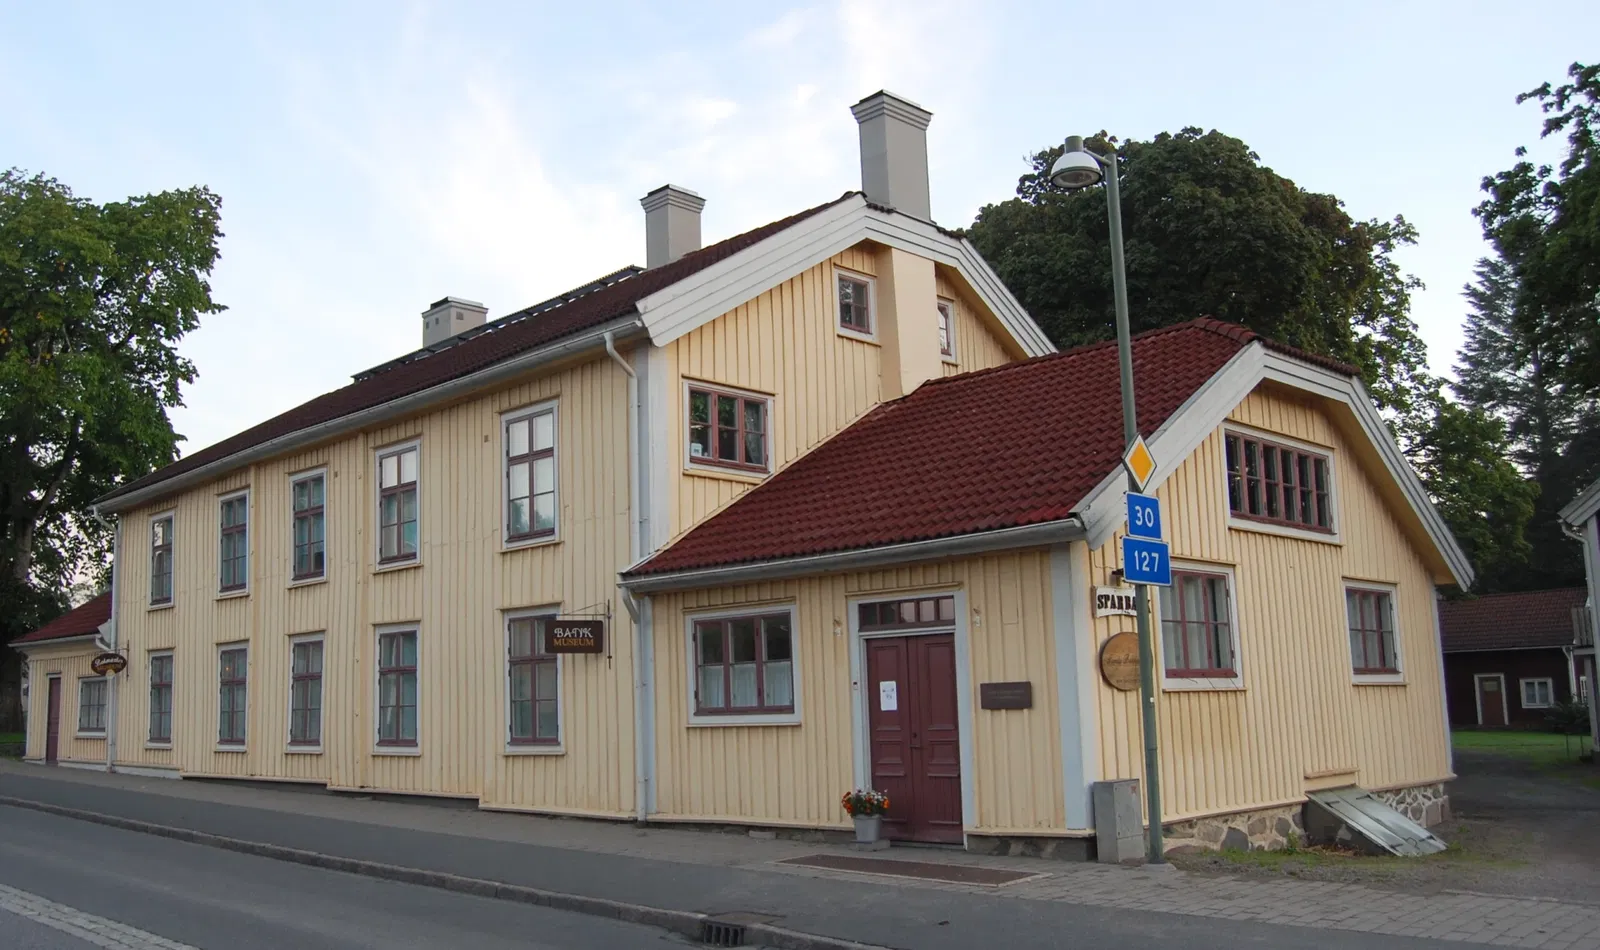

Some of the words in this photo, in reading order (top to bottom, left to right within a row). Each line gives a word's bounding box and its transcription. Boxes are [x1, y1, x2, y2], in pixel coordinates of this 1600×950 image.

[1134, 505, 1154, 528] 30
[1134, 550, 1160, 573] 127
[1097, 594, 1151, 613] SPARBA
[553, 638, 595, 647] MUSEUM
